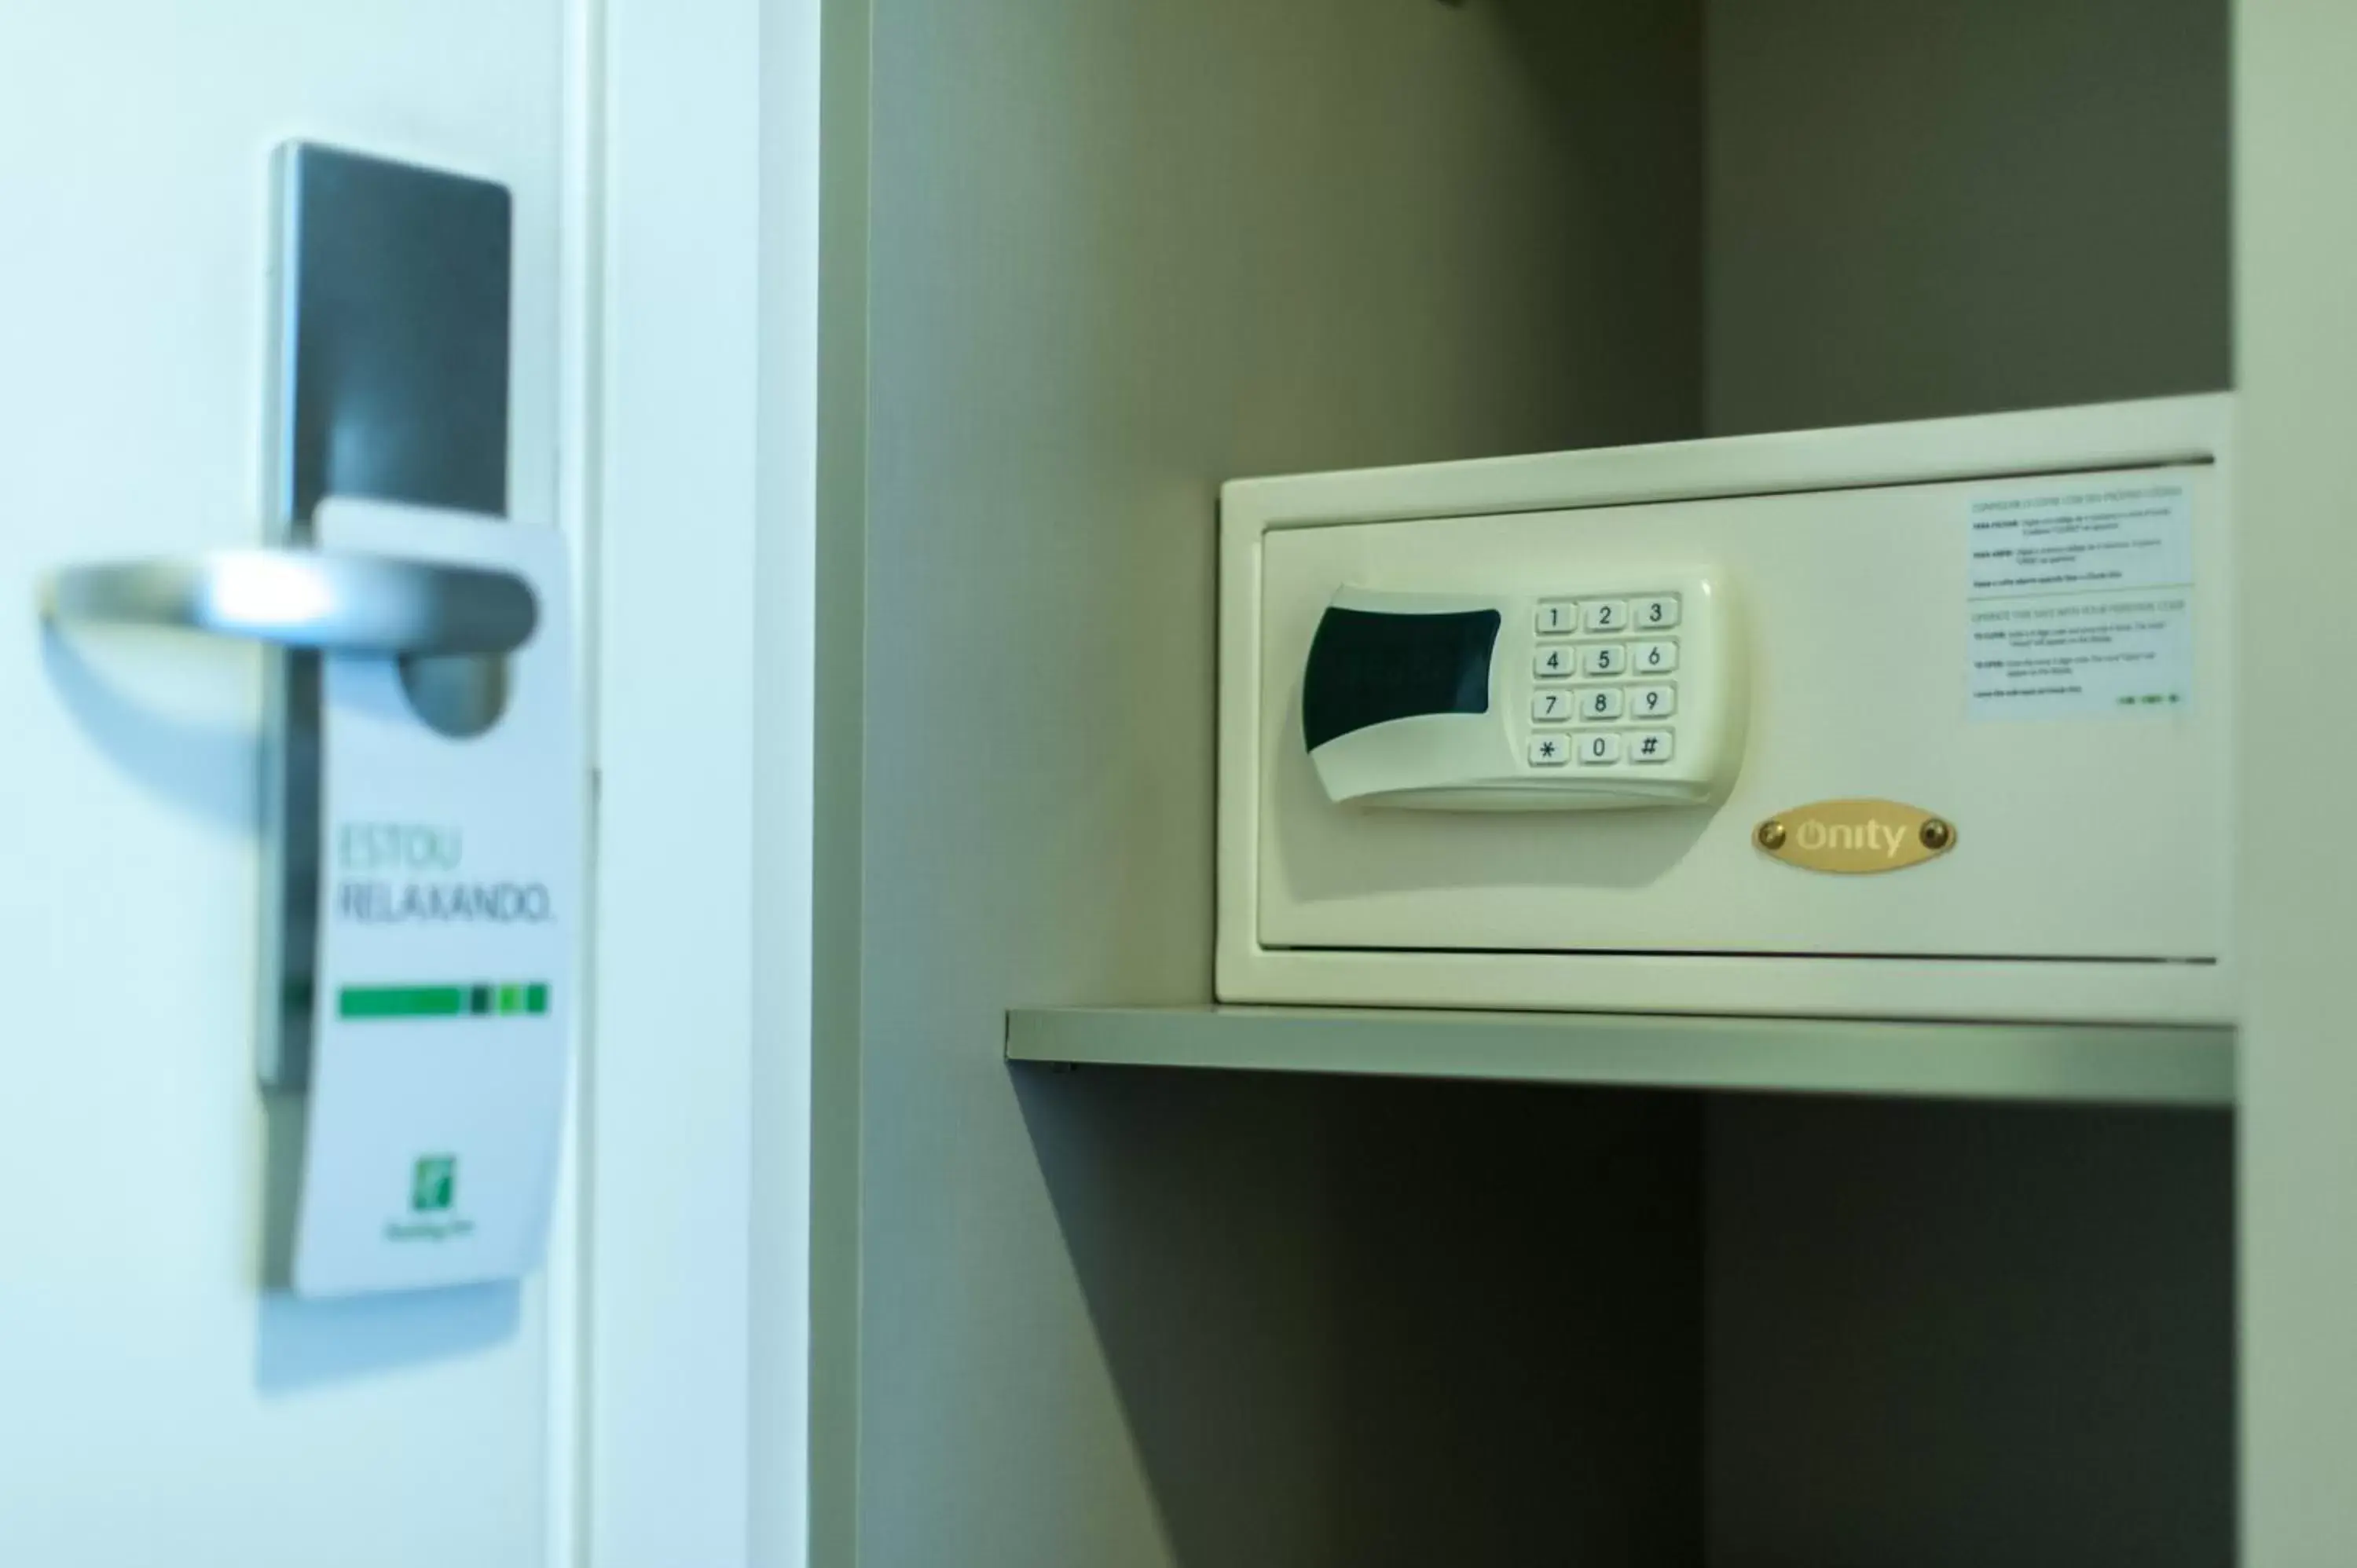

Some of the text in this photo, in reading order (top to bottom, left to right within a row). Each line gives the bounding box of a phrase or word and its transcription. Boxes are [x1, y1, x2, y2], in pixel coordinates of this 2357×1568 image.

[1550, 604, 1662, 626] 1 2 3
[1547, 647, 1660, 669] 4 5 6
[1545, 691, 1658, 714] 7 8 9
[1593, 738, 1605, 757] 0
[1642, 738, 1658, 754] #
[339, 822, 464, 870] ESTOU
[1796, 819, 1906, 859] Onity
